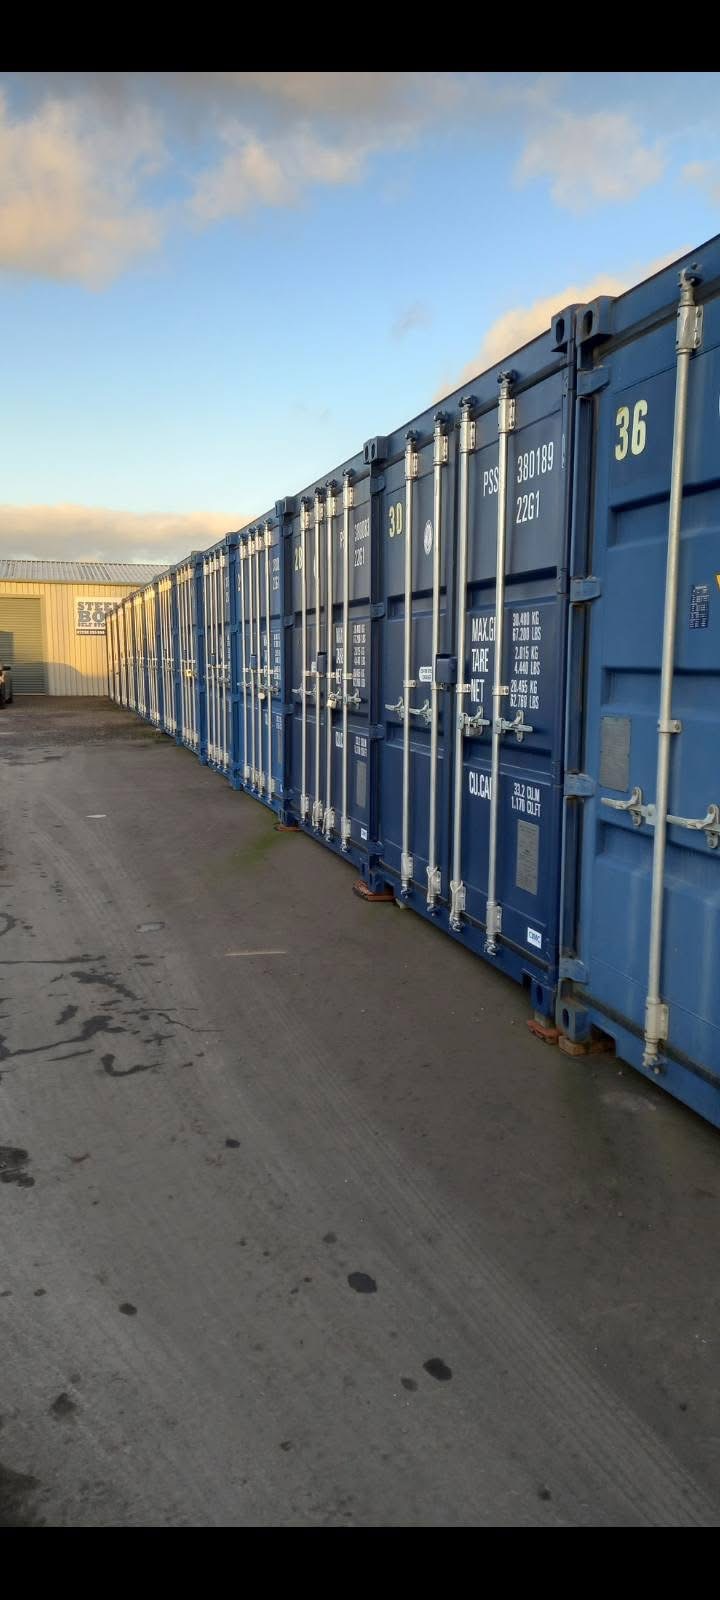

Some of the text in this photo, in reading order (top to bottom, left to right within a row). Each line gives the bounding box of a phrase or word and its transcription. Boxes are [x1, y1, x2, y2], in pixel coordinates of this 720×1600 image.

[615, 399, 648, 461] 36
[517, 441, 554, 483] 380189
[516, 490, 540, 524] 22G1
[531, 611, 540, 626] KG
[531, 626, 542, 641] LBS
[530, 645, 539, 660] KG
[471, 648, 489, 673] TARE
[530, 661, 541, 675] LBS
[470, 678, 485, 703] NET
[529, 680, 538, 694] KG
[529, 695, 540, 709] LBS
[513, 782, 525, 797] 33.2
[526, 801, 541, 817] CU.FT
